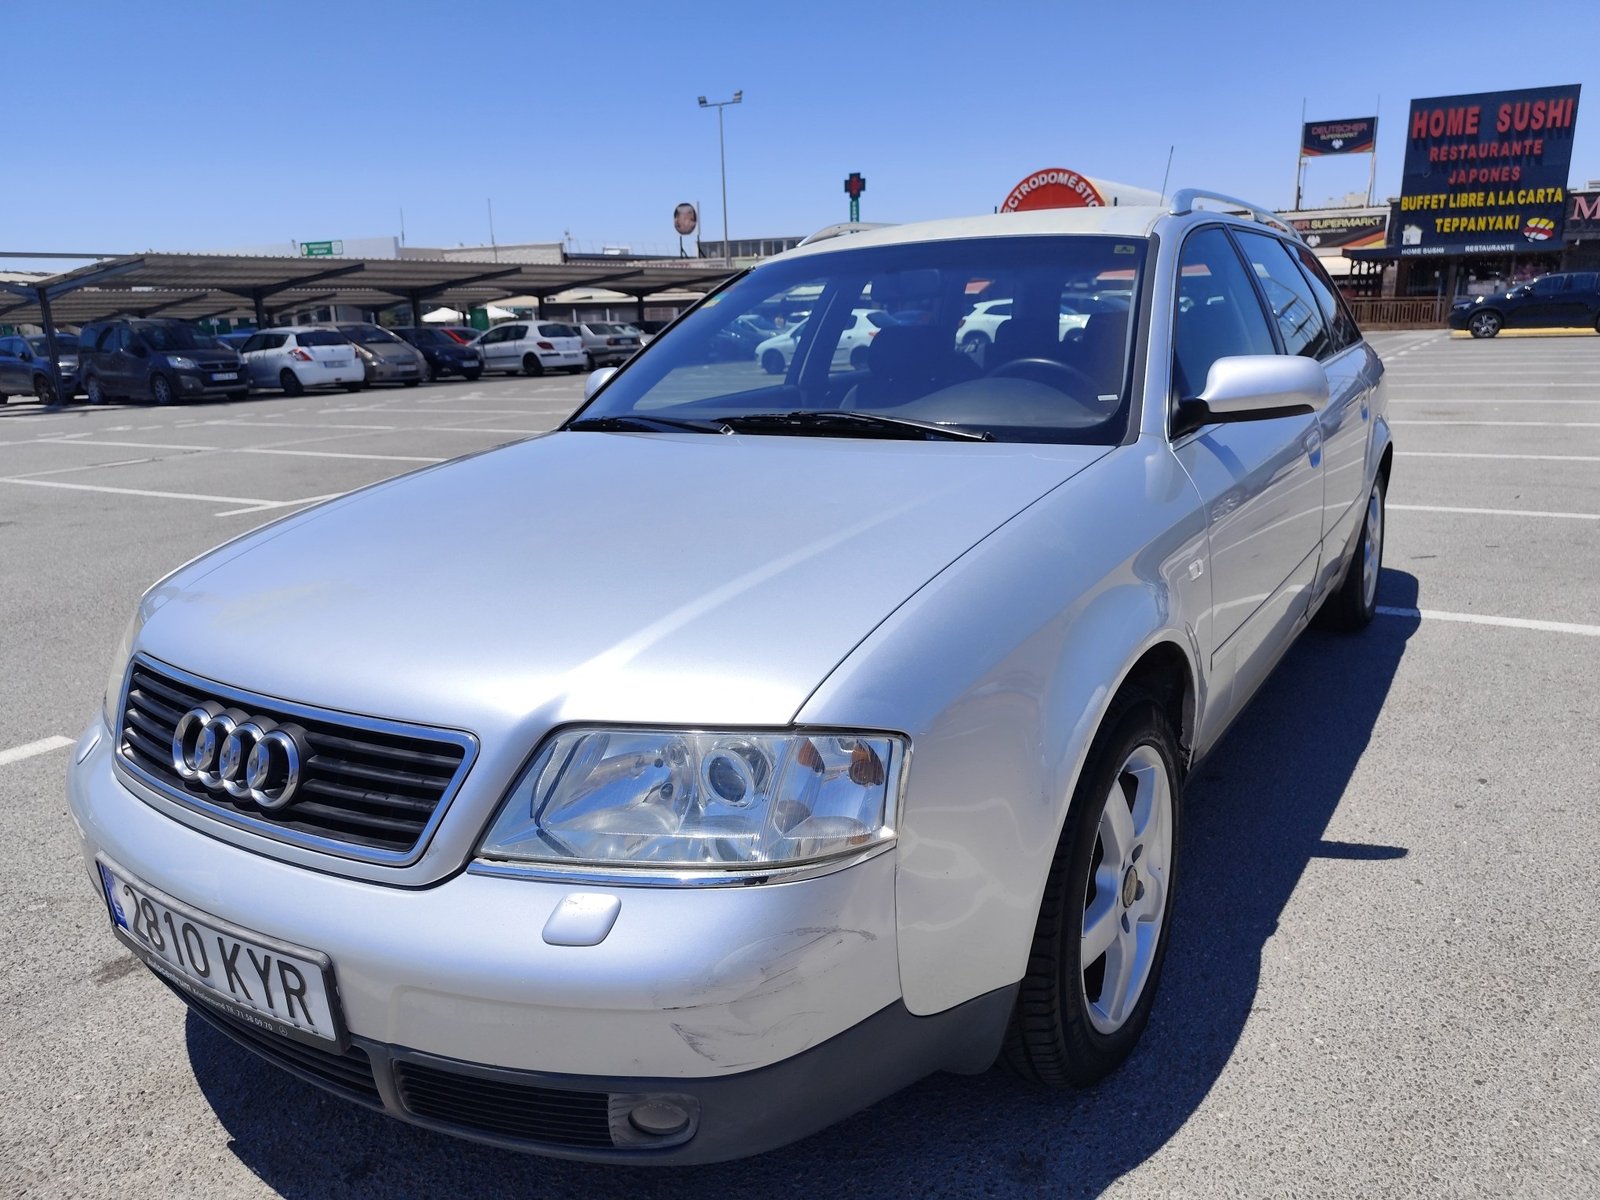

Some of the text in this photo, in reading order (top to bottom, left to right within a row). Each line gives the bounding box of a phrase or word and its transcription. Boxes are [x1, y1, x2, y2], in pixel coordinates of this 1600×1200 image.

[1412, 98, 1574, 139] HOME SUSHI
[1429, 139, 1544, 162] RESTAURANTE
[1448, 166, 1521, 185] JAPONES
[1401, 187, 1563, 211] BUFFET LIBRE A LA CARTA
[1311, 217, 1382, 230] SUPERMARKT
[1435, 214, 1520, 233] TEPPANYAKI
[1423, 247, 1445, 255] SUSHI
[1464, 244, 1515, 252] RESTAURANTE
[123, 884, 315, 1026] 2810 KYR
